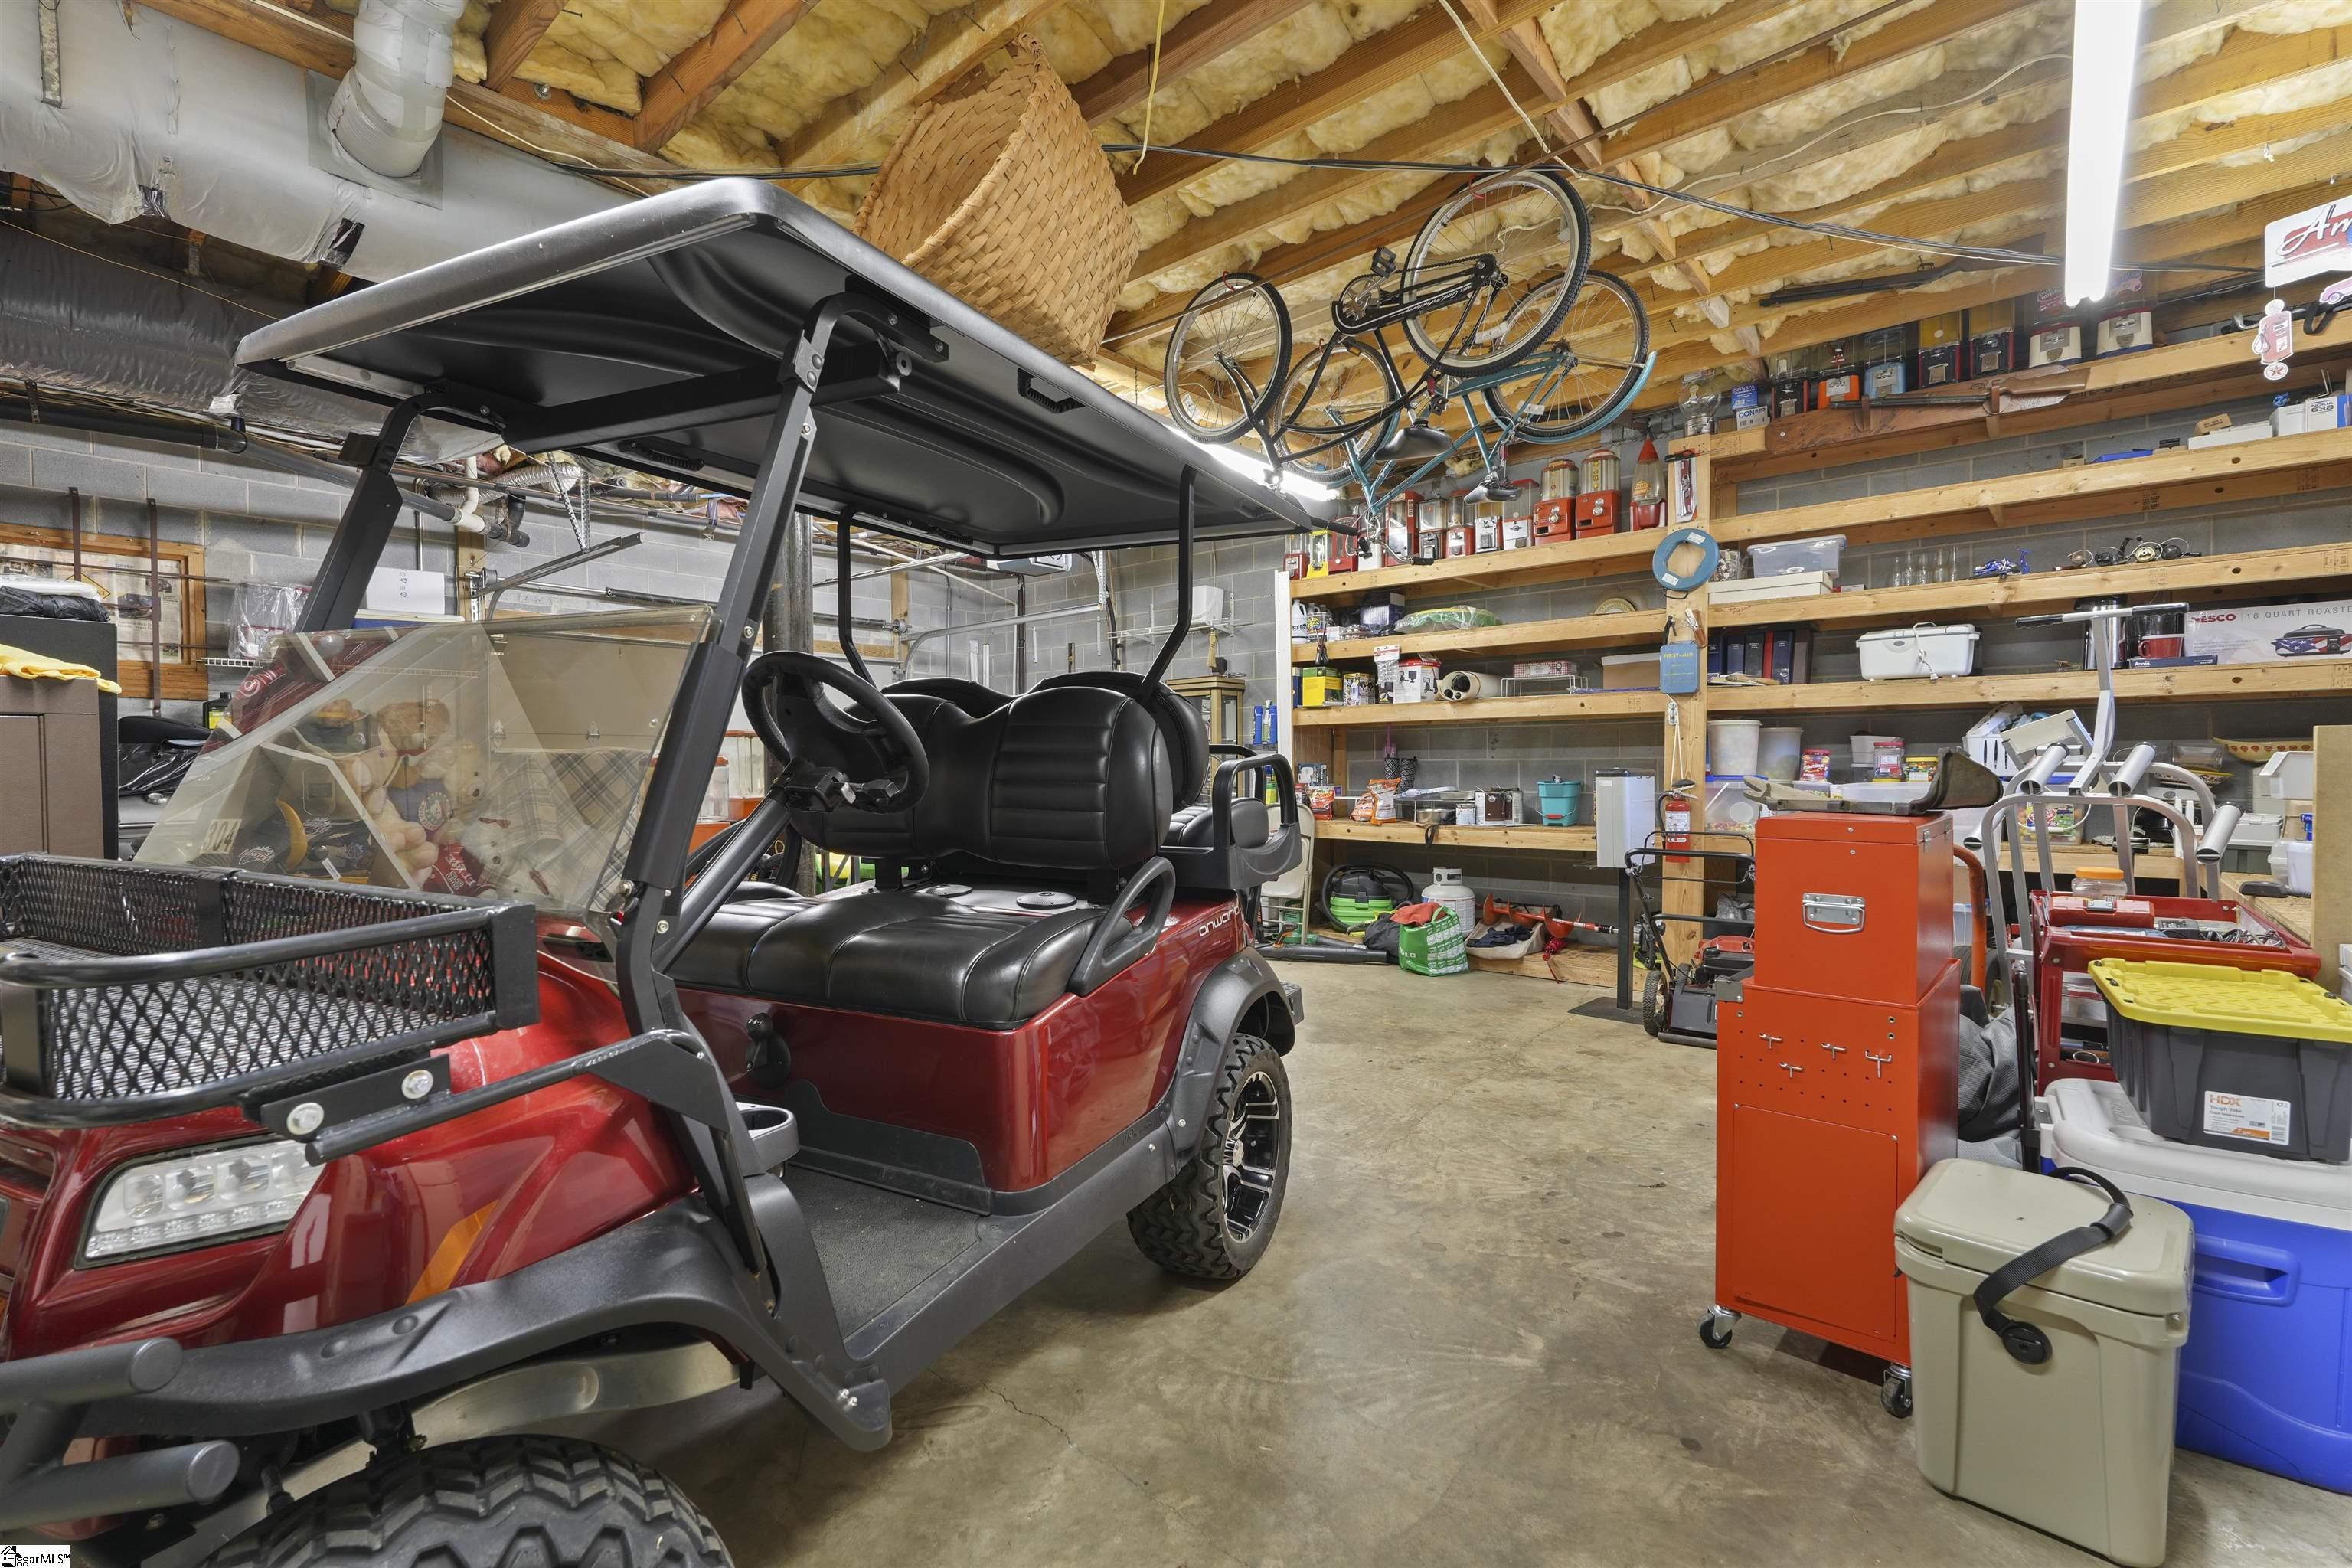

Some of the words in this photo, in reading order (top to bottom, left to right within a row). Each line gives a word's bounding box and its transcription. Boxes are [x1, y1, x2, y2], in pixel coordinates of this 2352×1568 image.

[1738, 407, 1766, 418] CONAIR
[2265, 609, 2301, 619] QUART
[2210, 1094, 2243, 1107] HDX
